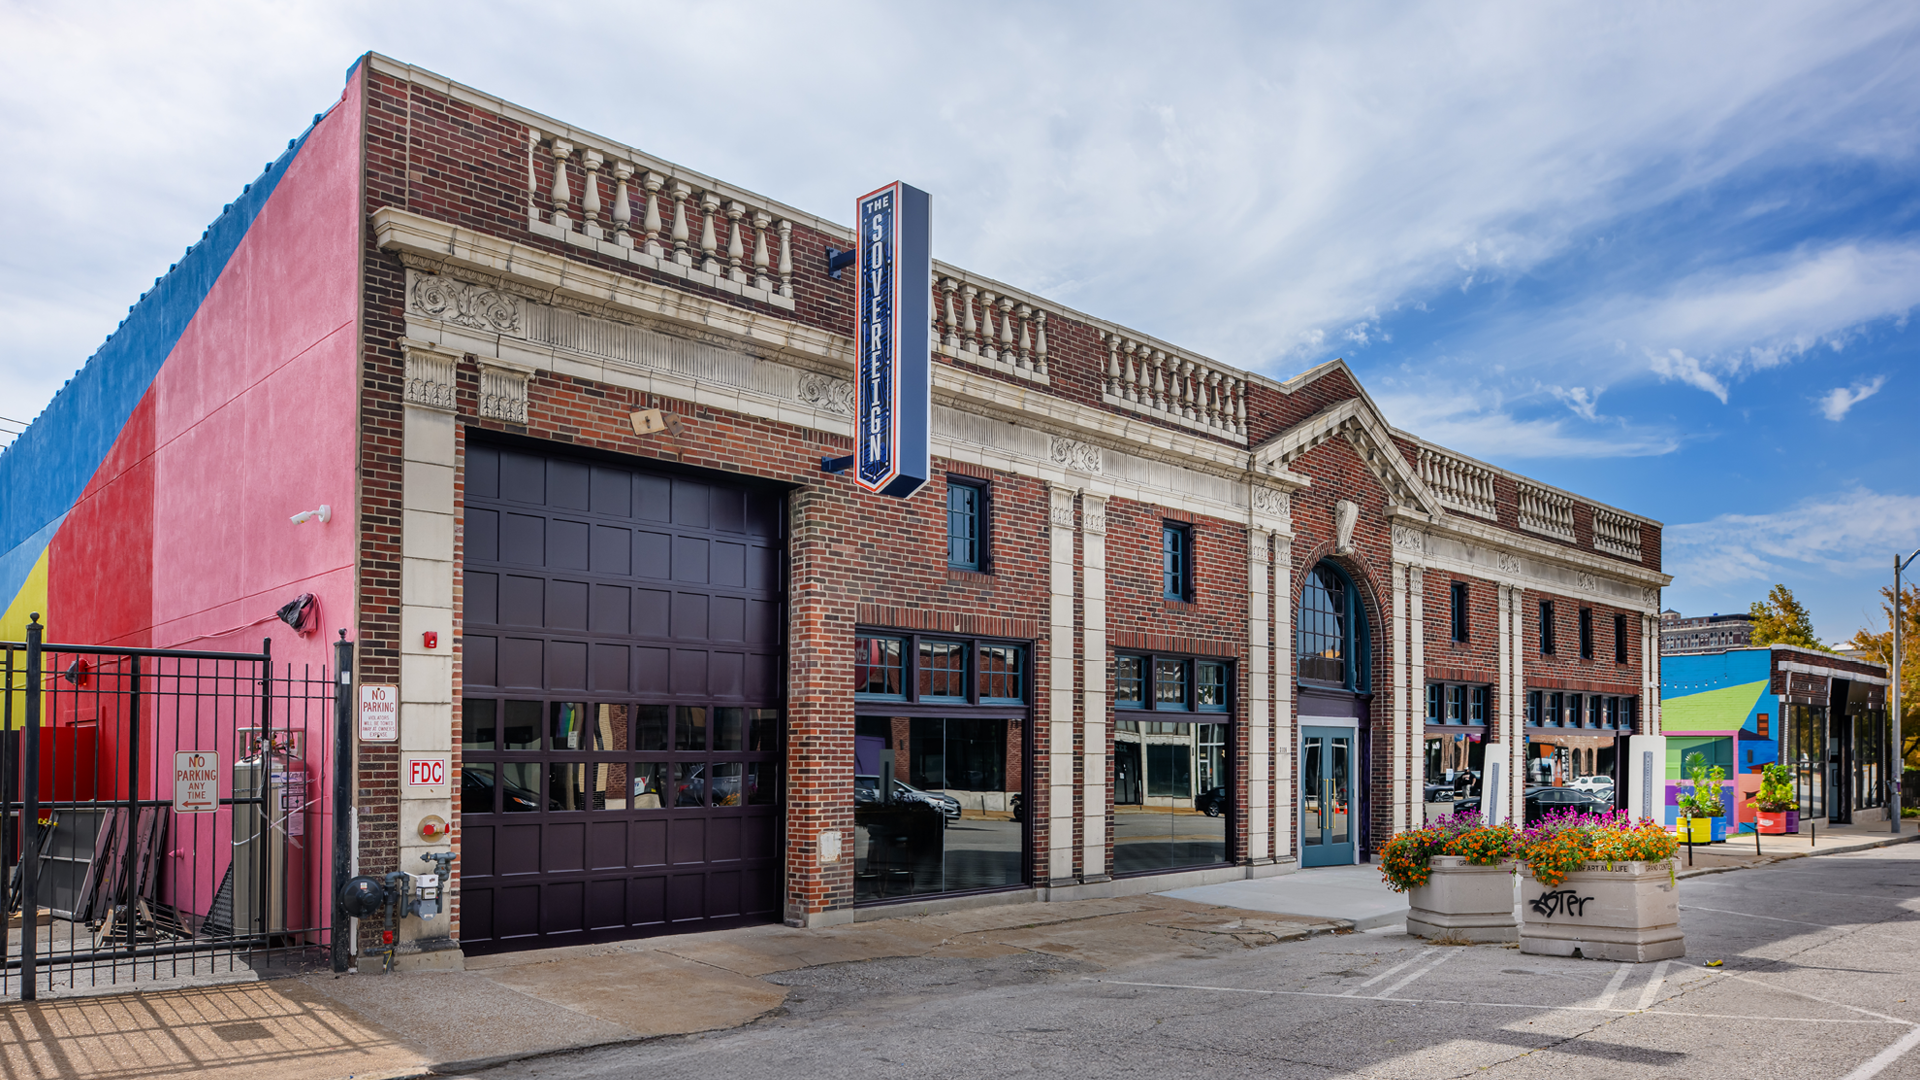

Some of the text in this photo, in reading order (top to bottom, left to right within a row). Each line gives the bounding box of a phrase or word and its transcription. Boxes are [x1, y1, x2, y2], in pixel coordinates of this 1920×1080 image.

[866, 195, 889, 214] THE
[870, 213, 884, 463] SOVEREIGN
[371, 690, 386, 700] NO
[363, 702, 394, 712] PARKING
[188, 756, 206, 768] NO
[177, 769, 217, 781] PARKING
[412, 762, 442, 783] FDC
[188, 782, 206, 790] ANY
[187, 791, 207, 800] TIME
[1615, 865, 1628, 873] LIFE
